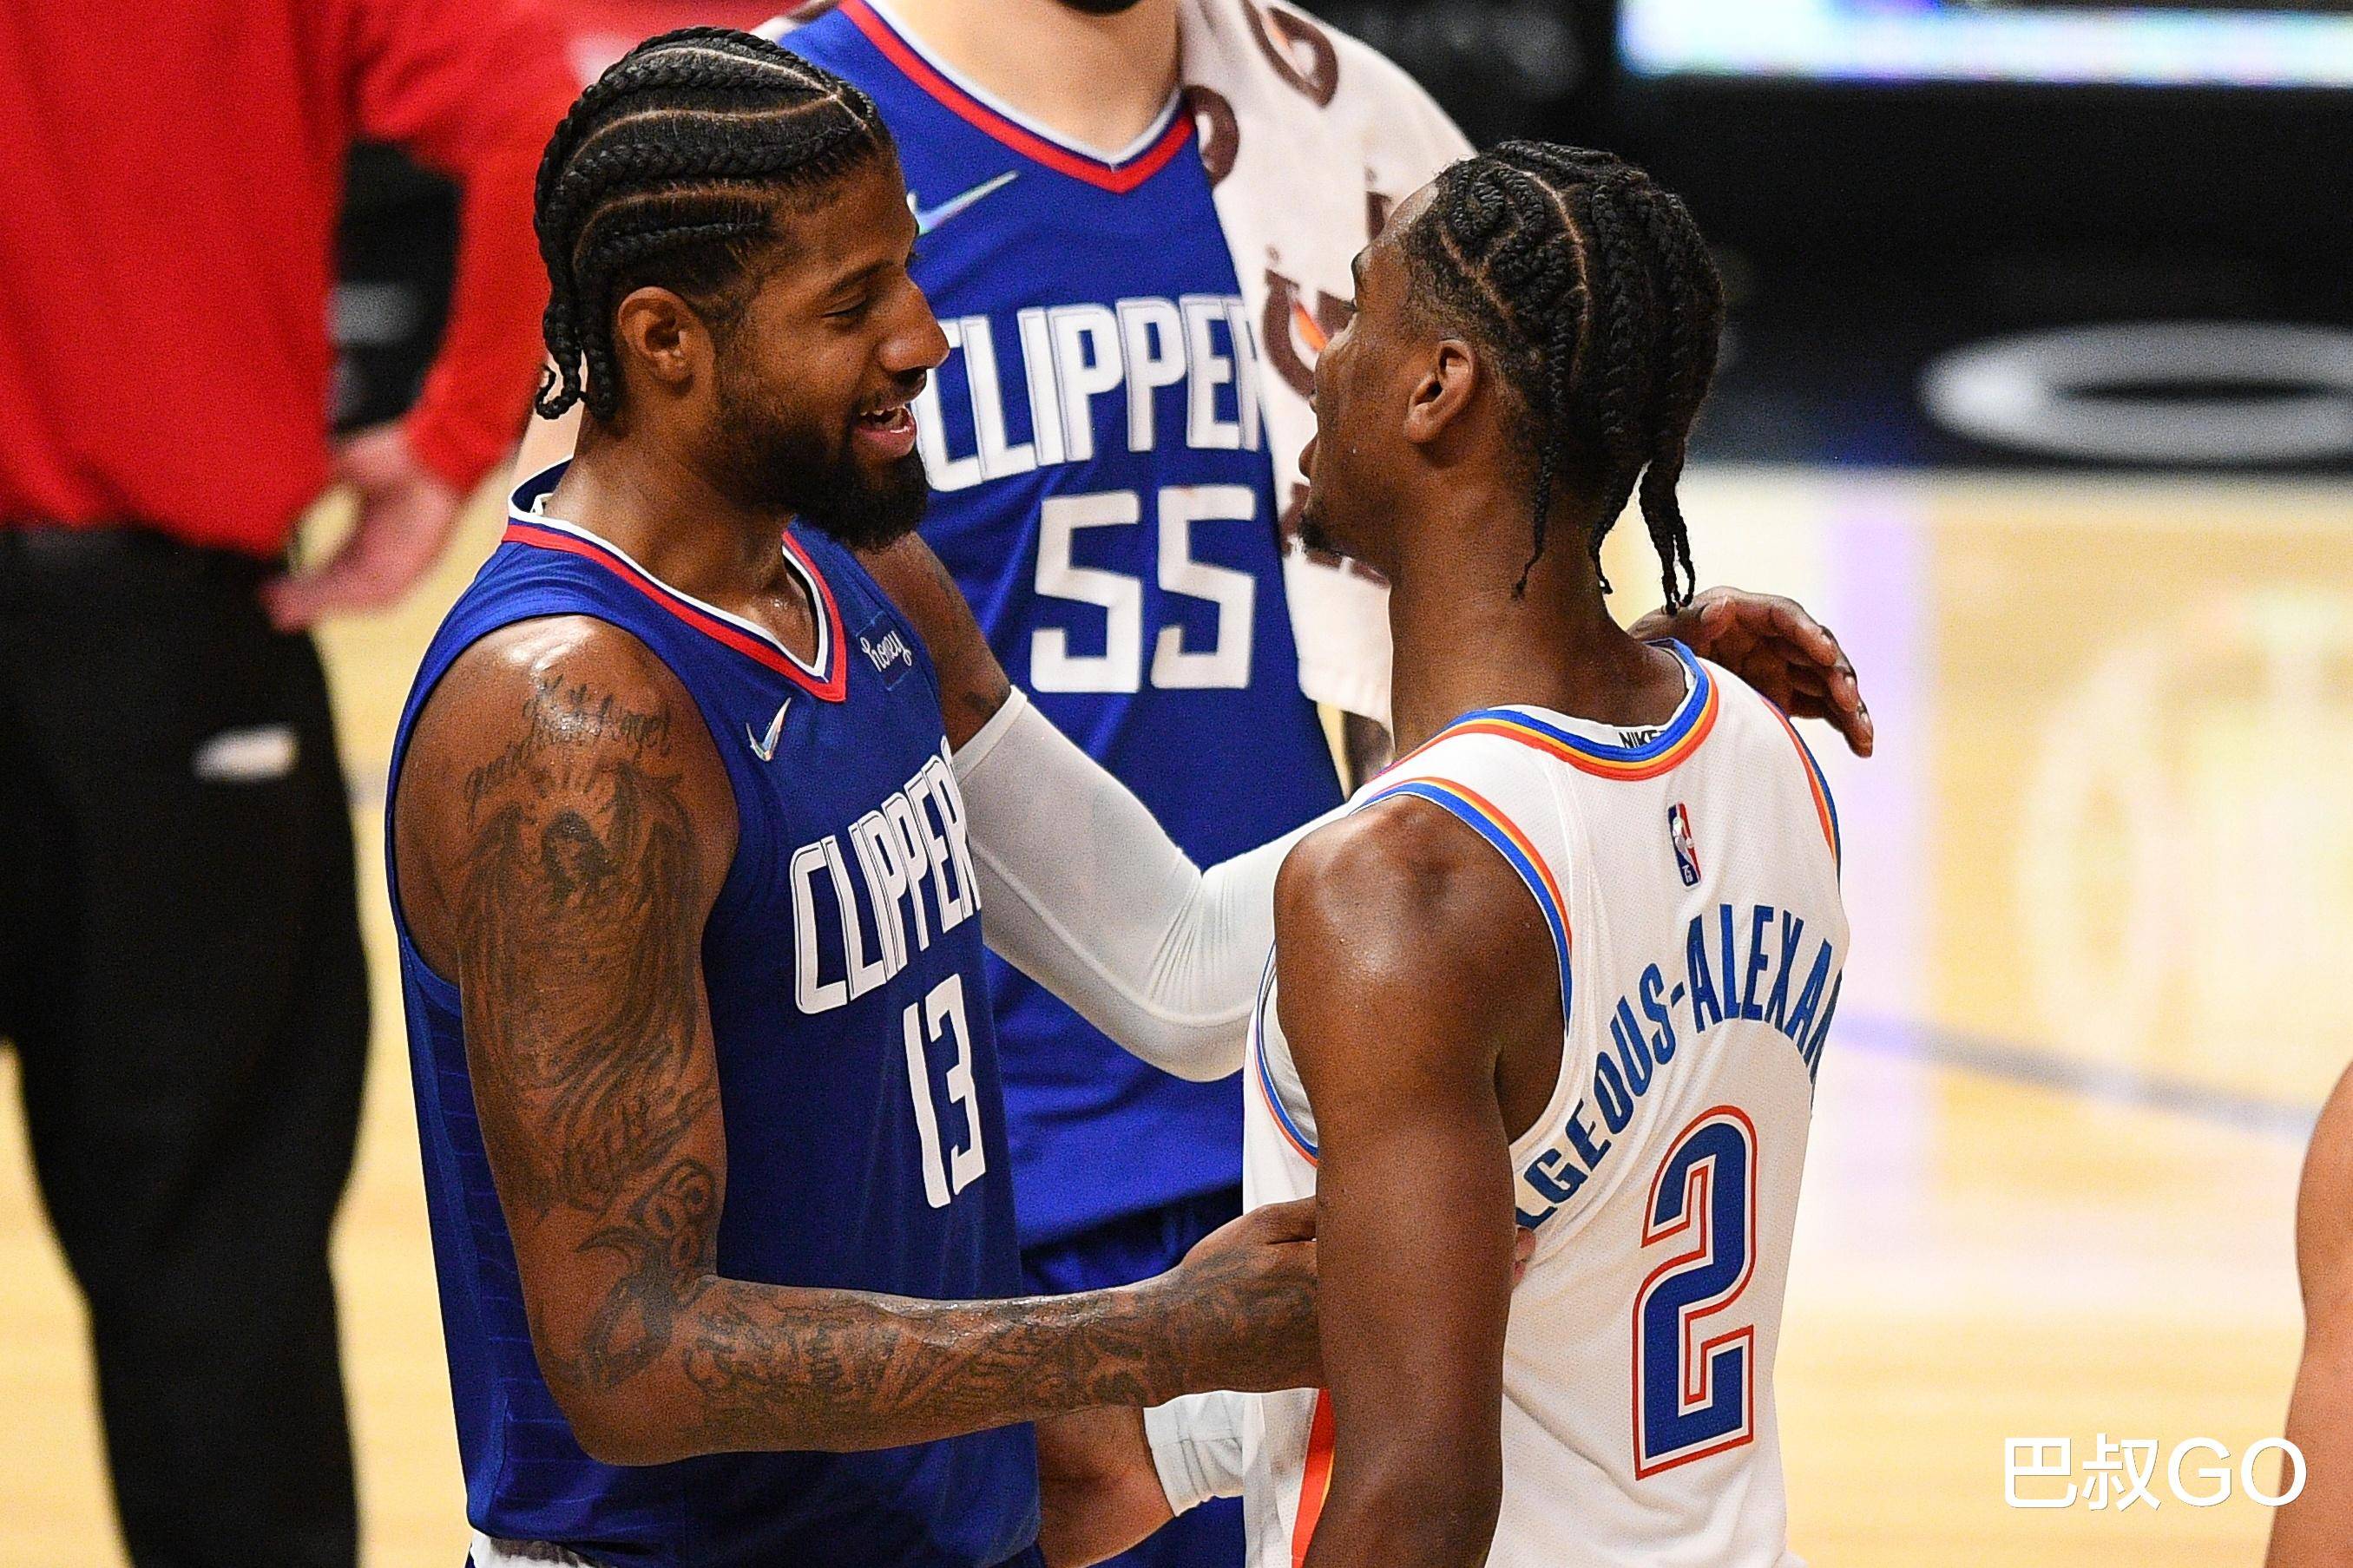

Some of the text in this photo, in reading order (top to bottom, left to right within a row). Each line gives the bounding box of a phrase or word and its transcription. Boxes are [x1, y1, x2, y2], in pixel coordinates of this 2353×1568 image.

[859, 630, 912, 672] honey
[1030, 482, 1256, 693] 55
[790, 736, 982, 1014] CLIPPER
[903, 974, 986, 1208] 13
[1632, 1105, 1758, 1481] 2
